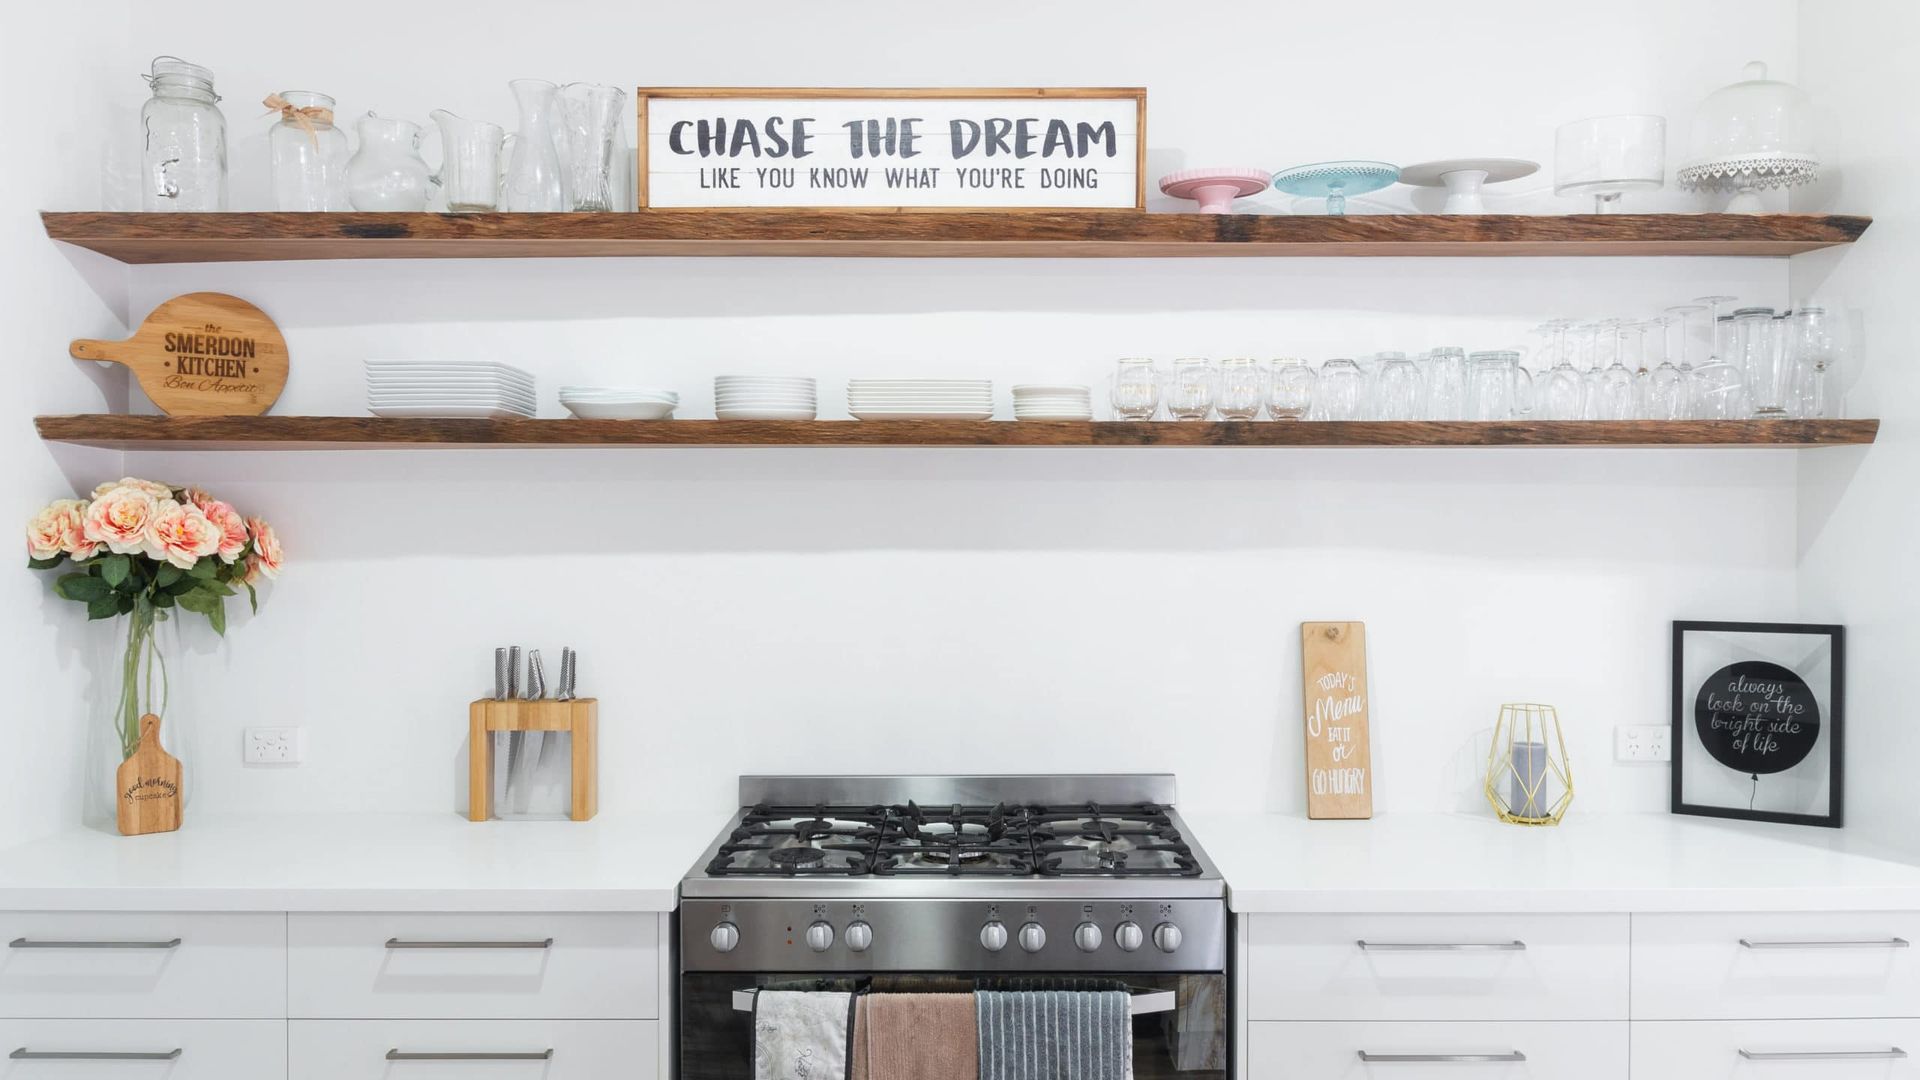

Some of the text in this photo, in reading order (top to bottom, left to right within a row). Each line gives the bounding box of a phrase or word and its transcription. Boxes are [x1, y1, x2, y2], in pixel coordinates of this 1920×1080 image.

[669, 116, 1117, 160] CHASE THE DREAM
[699, 167, 1099, 190] LIKE YOU KNOW WHAT YOU'RE DOING
[204, 323, 223, 334] the
[164, 332, 256, 359] SMERDON
[176, 355, 247, 379] KITCHEN
[163, 374, 196, 389] Bon
[1316, 671, 1357, 692] TODAY'S
[1728, 674, 1784, 700] always
[1707, 692, 1807, 715] look on the
[1308, 695, 1365, 737] Menu
[1711, 712, 1802, 737] bright side
[1328, 727, 1342, 742] EAT
[1732, 733, 1780, 755] of life
[1312, 767, 1365, 795] GO HUNGRY
